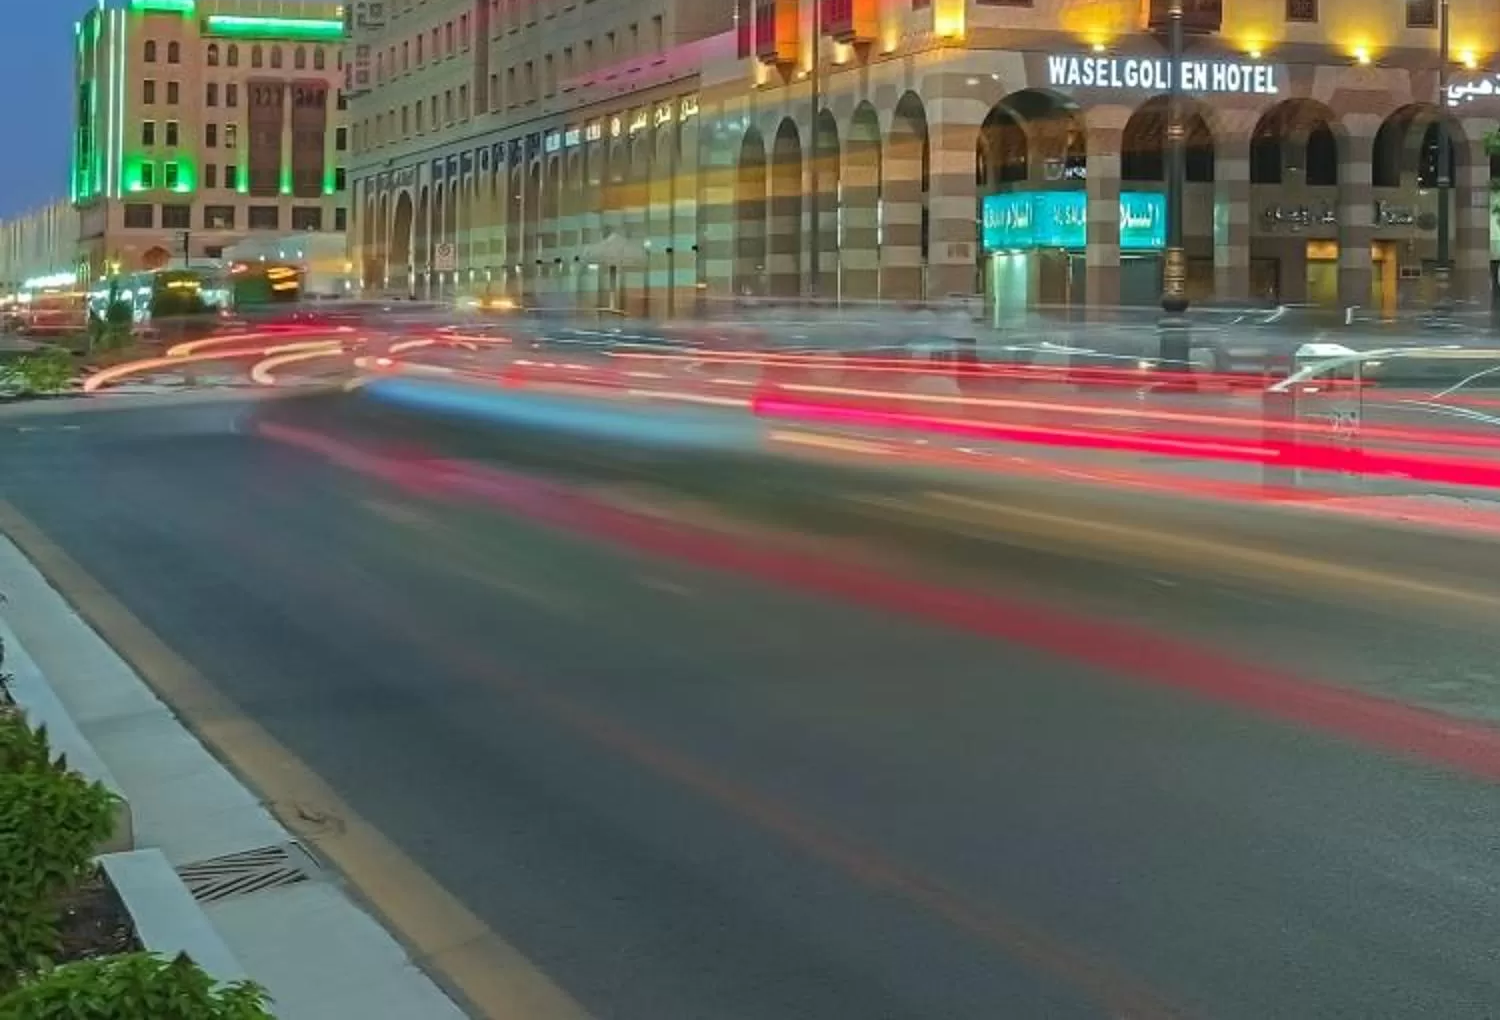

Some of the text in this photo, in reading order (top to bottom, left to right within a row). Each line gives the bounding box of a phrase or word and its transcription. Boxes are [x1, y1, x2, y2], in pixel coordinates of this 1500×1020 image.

[1047, 56, 1280, 94] WASEL GOLEN HOTEL
